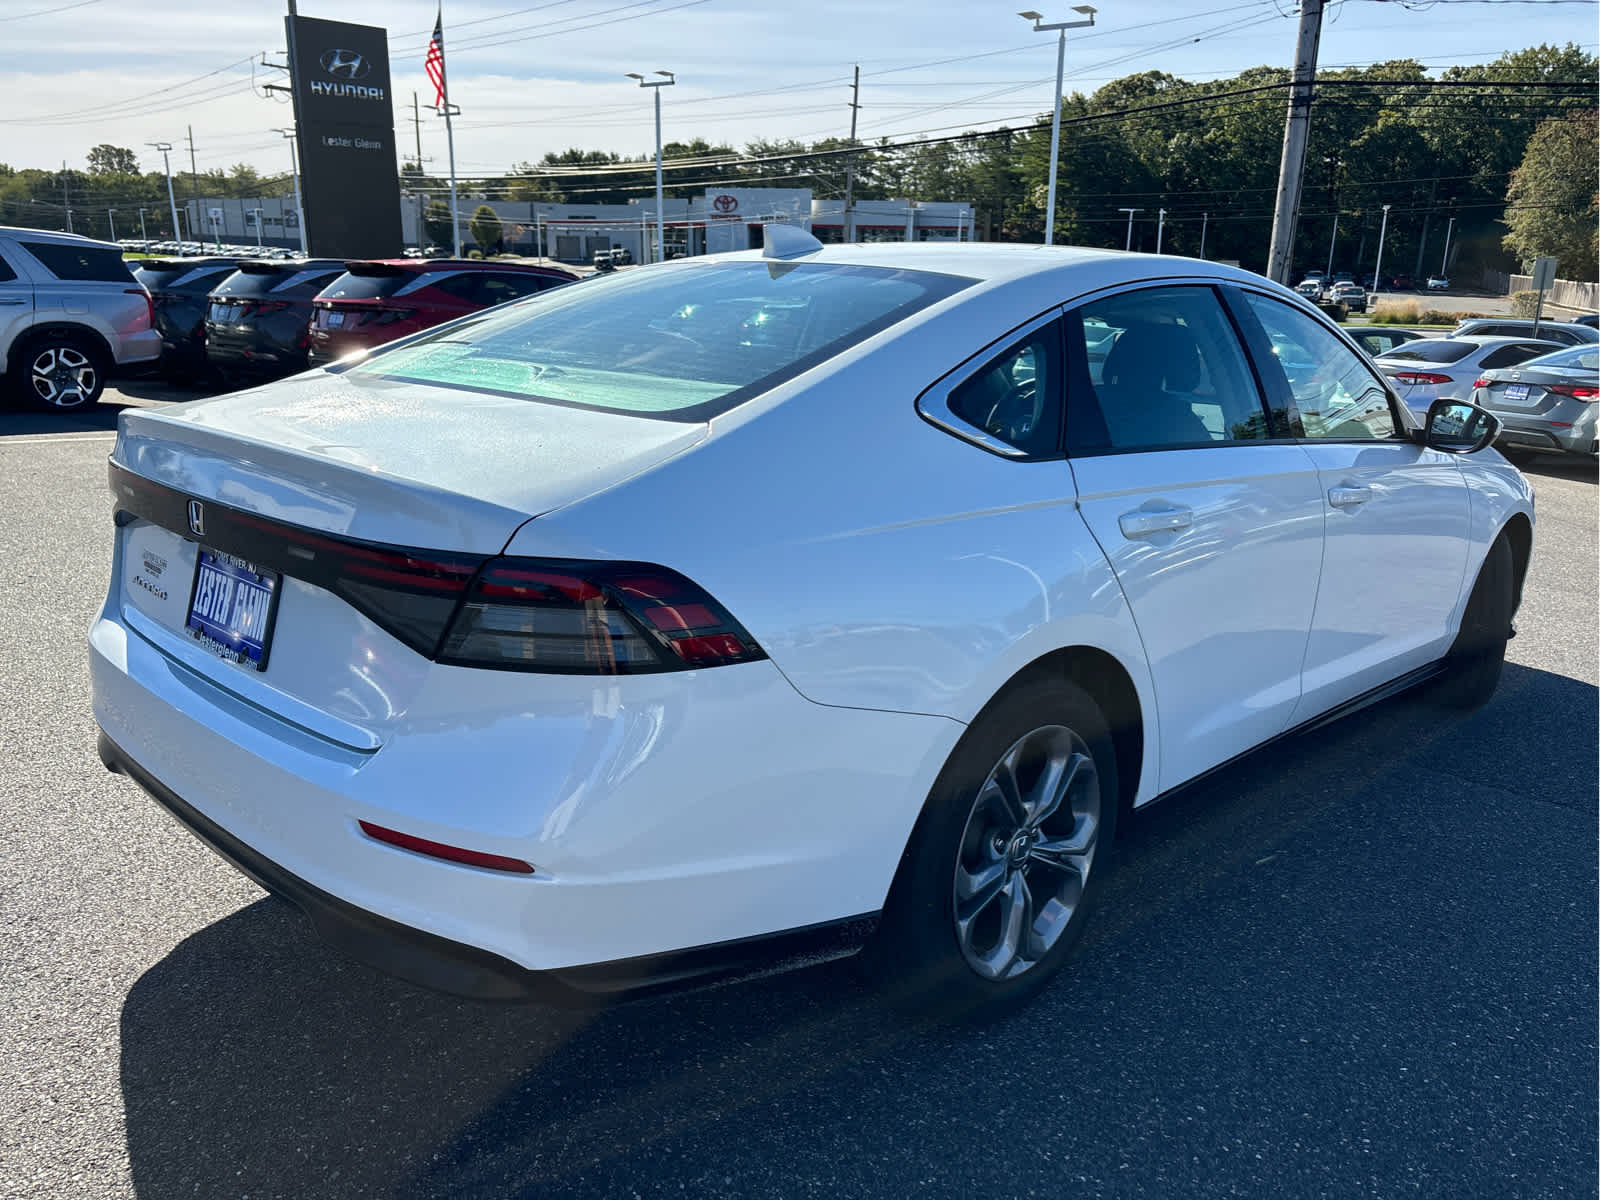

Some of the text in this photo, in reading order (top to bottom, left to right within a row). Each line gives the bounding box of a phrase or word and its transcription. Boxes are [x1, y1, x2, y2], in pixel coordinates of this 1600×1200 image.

[310, 80, 384, 100] HYUNDAI
[322, 135, 381, 149] Lester Glenn
[248, 562, 257, 574] NJ
[193, 566, 271, 641] LESTER GLENN
